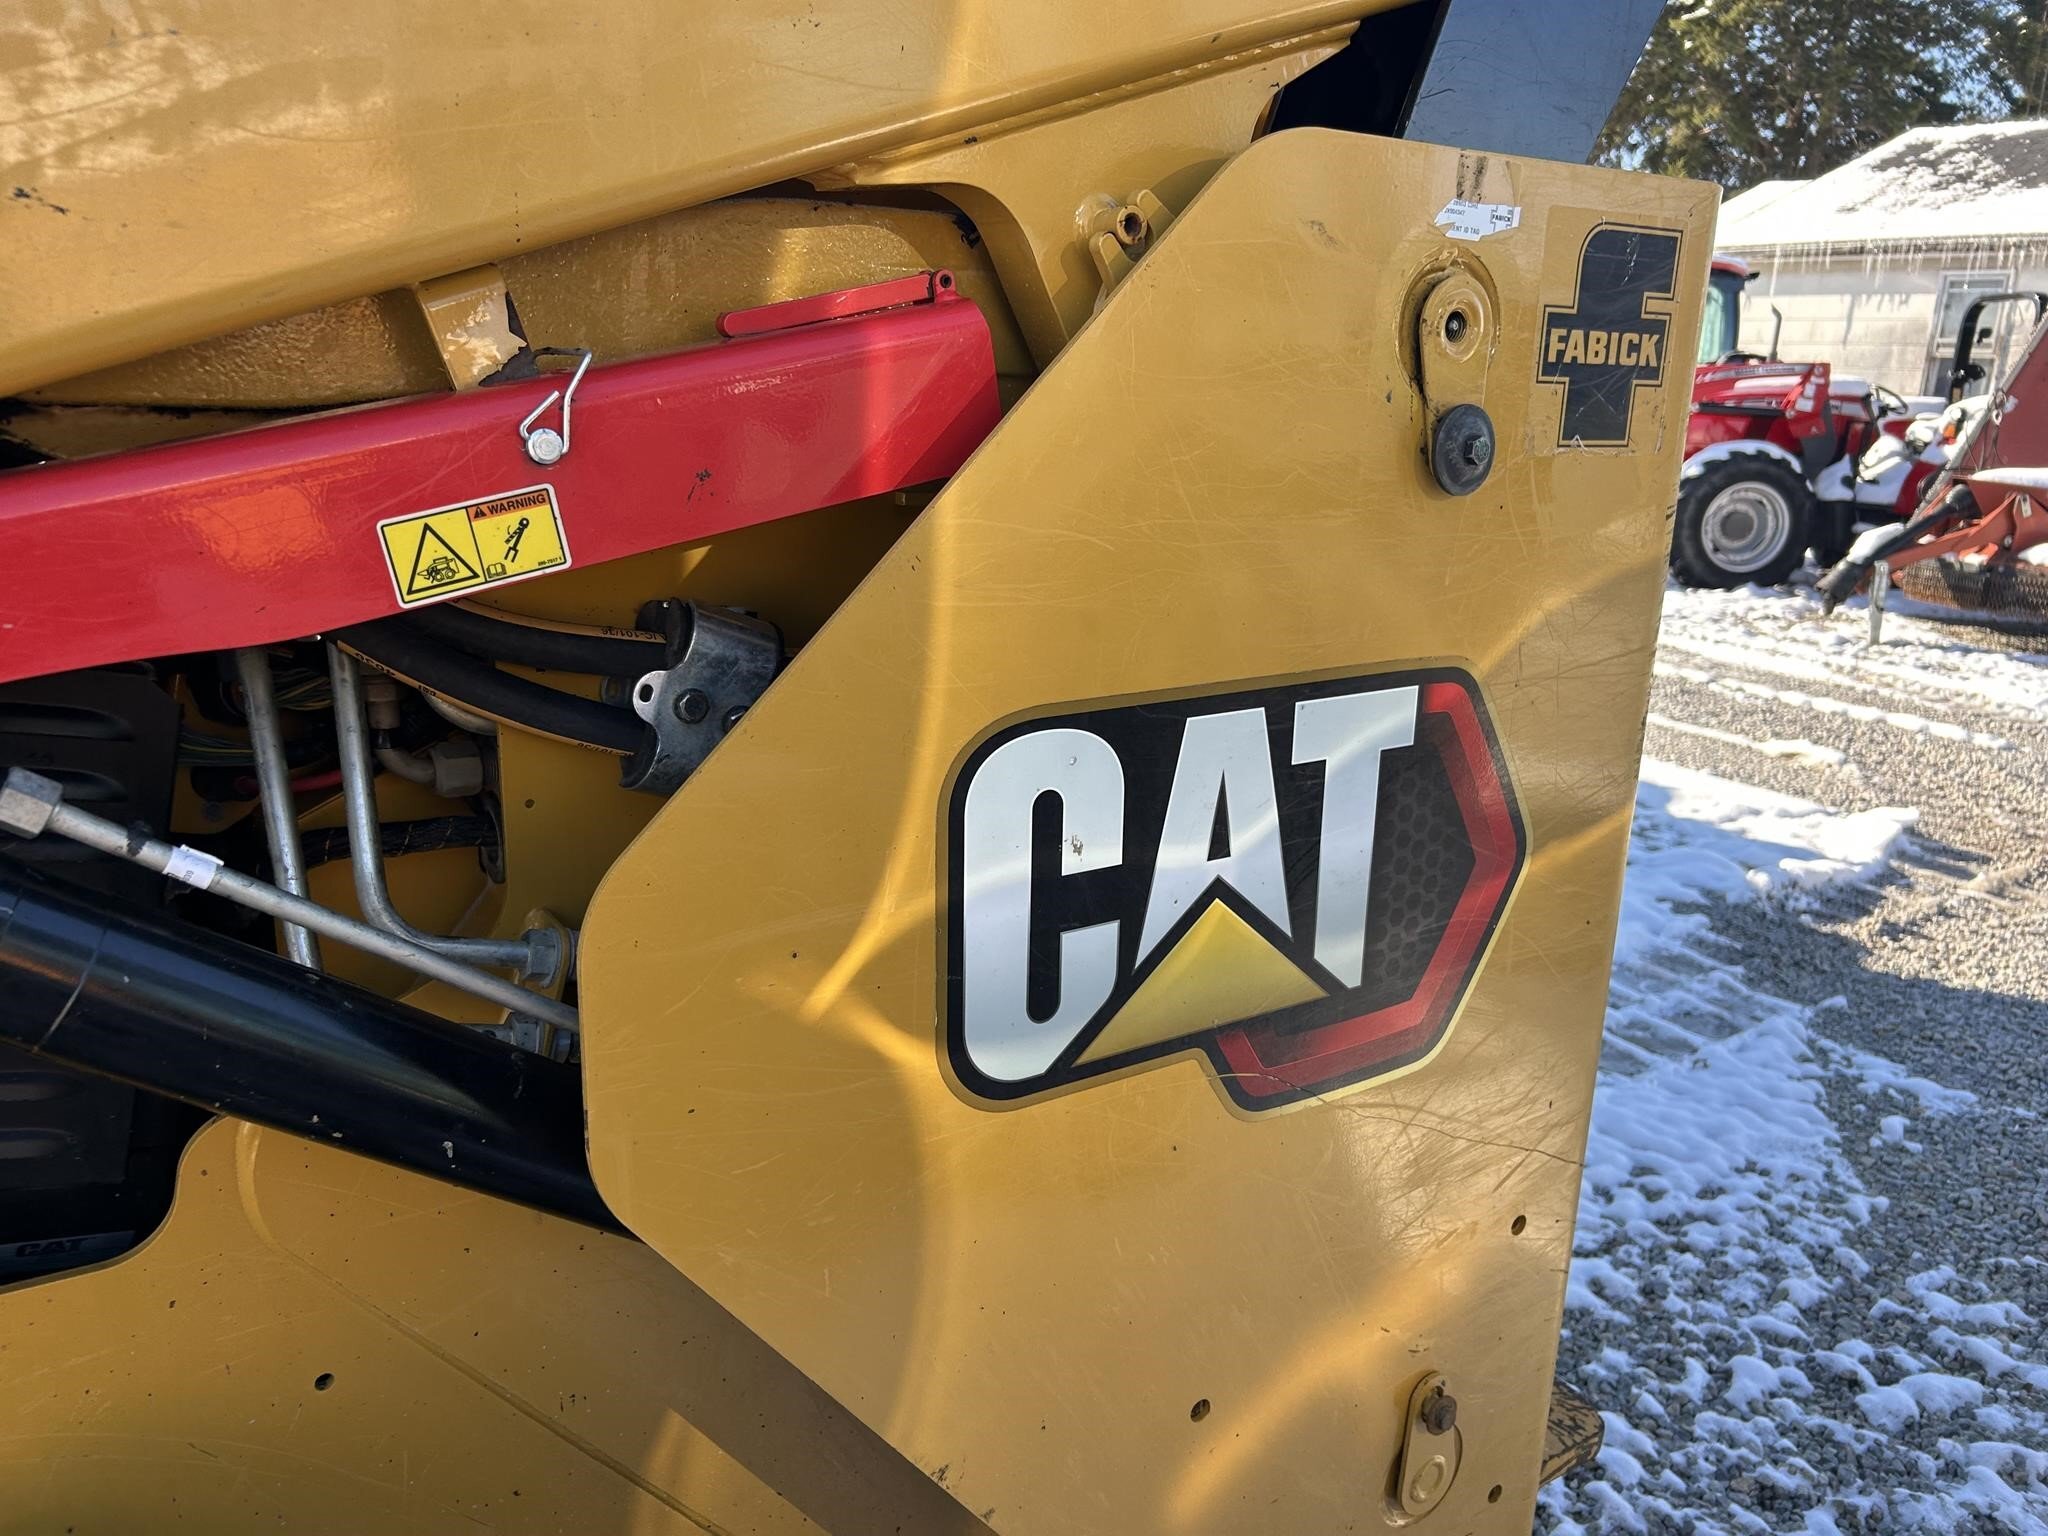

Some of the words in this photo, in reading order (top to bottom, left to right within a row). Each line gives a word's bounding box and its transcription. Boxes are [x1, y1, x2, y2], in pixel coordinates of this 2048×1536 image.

[1492, 213, 1511, 222] FABICK
[1547, 328, 1660, 368] FABICK
[487, 494, 546, 515] WARNING
[964, 685, 1419, 1082] CAT
[16, 1238, 92, 1258] CAT
